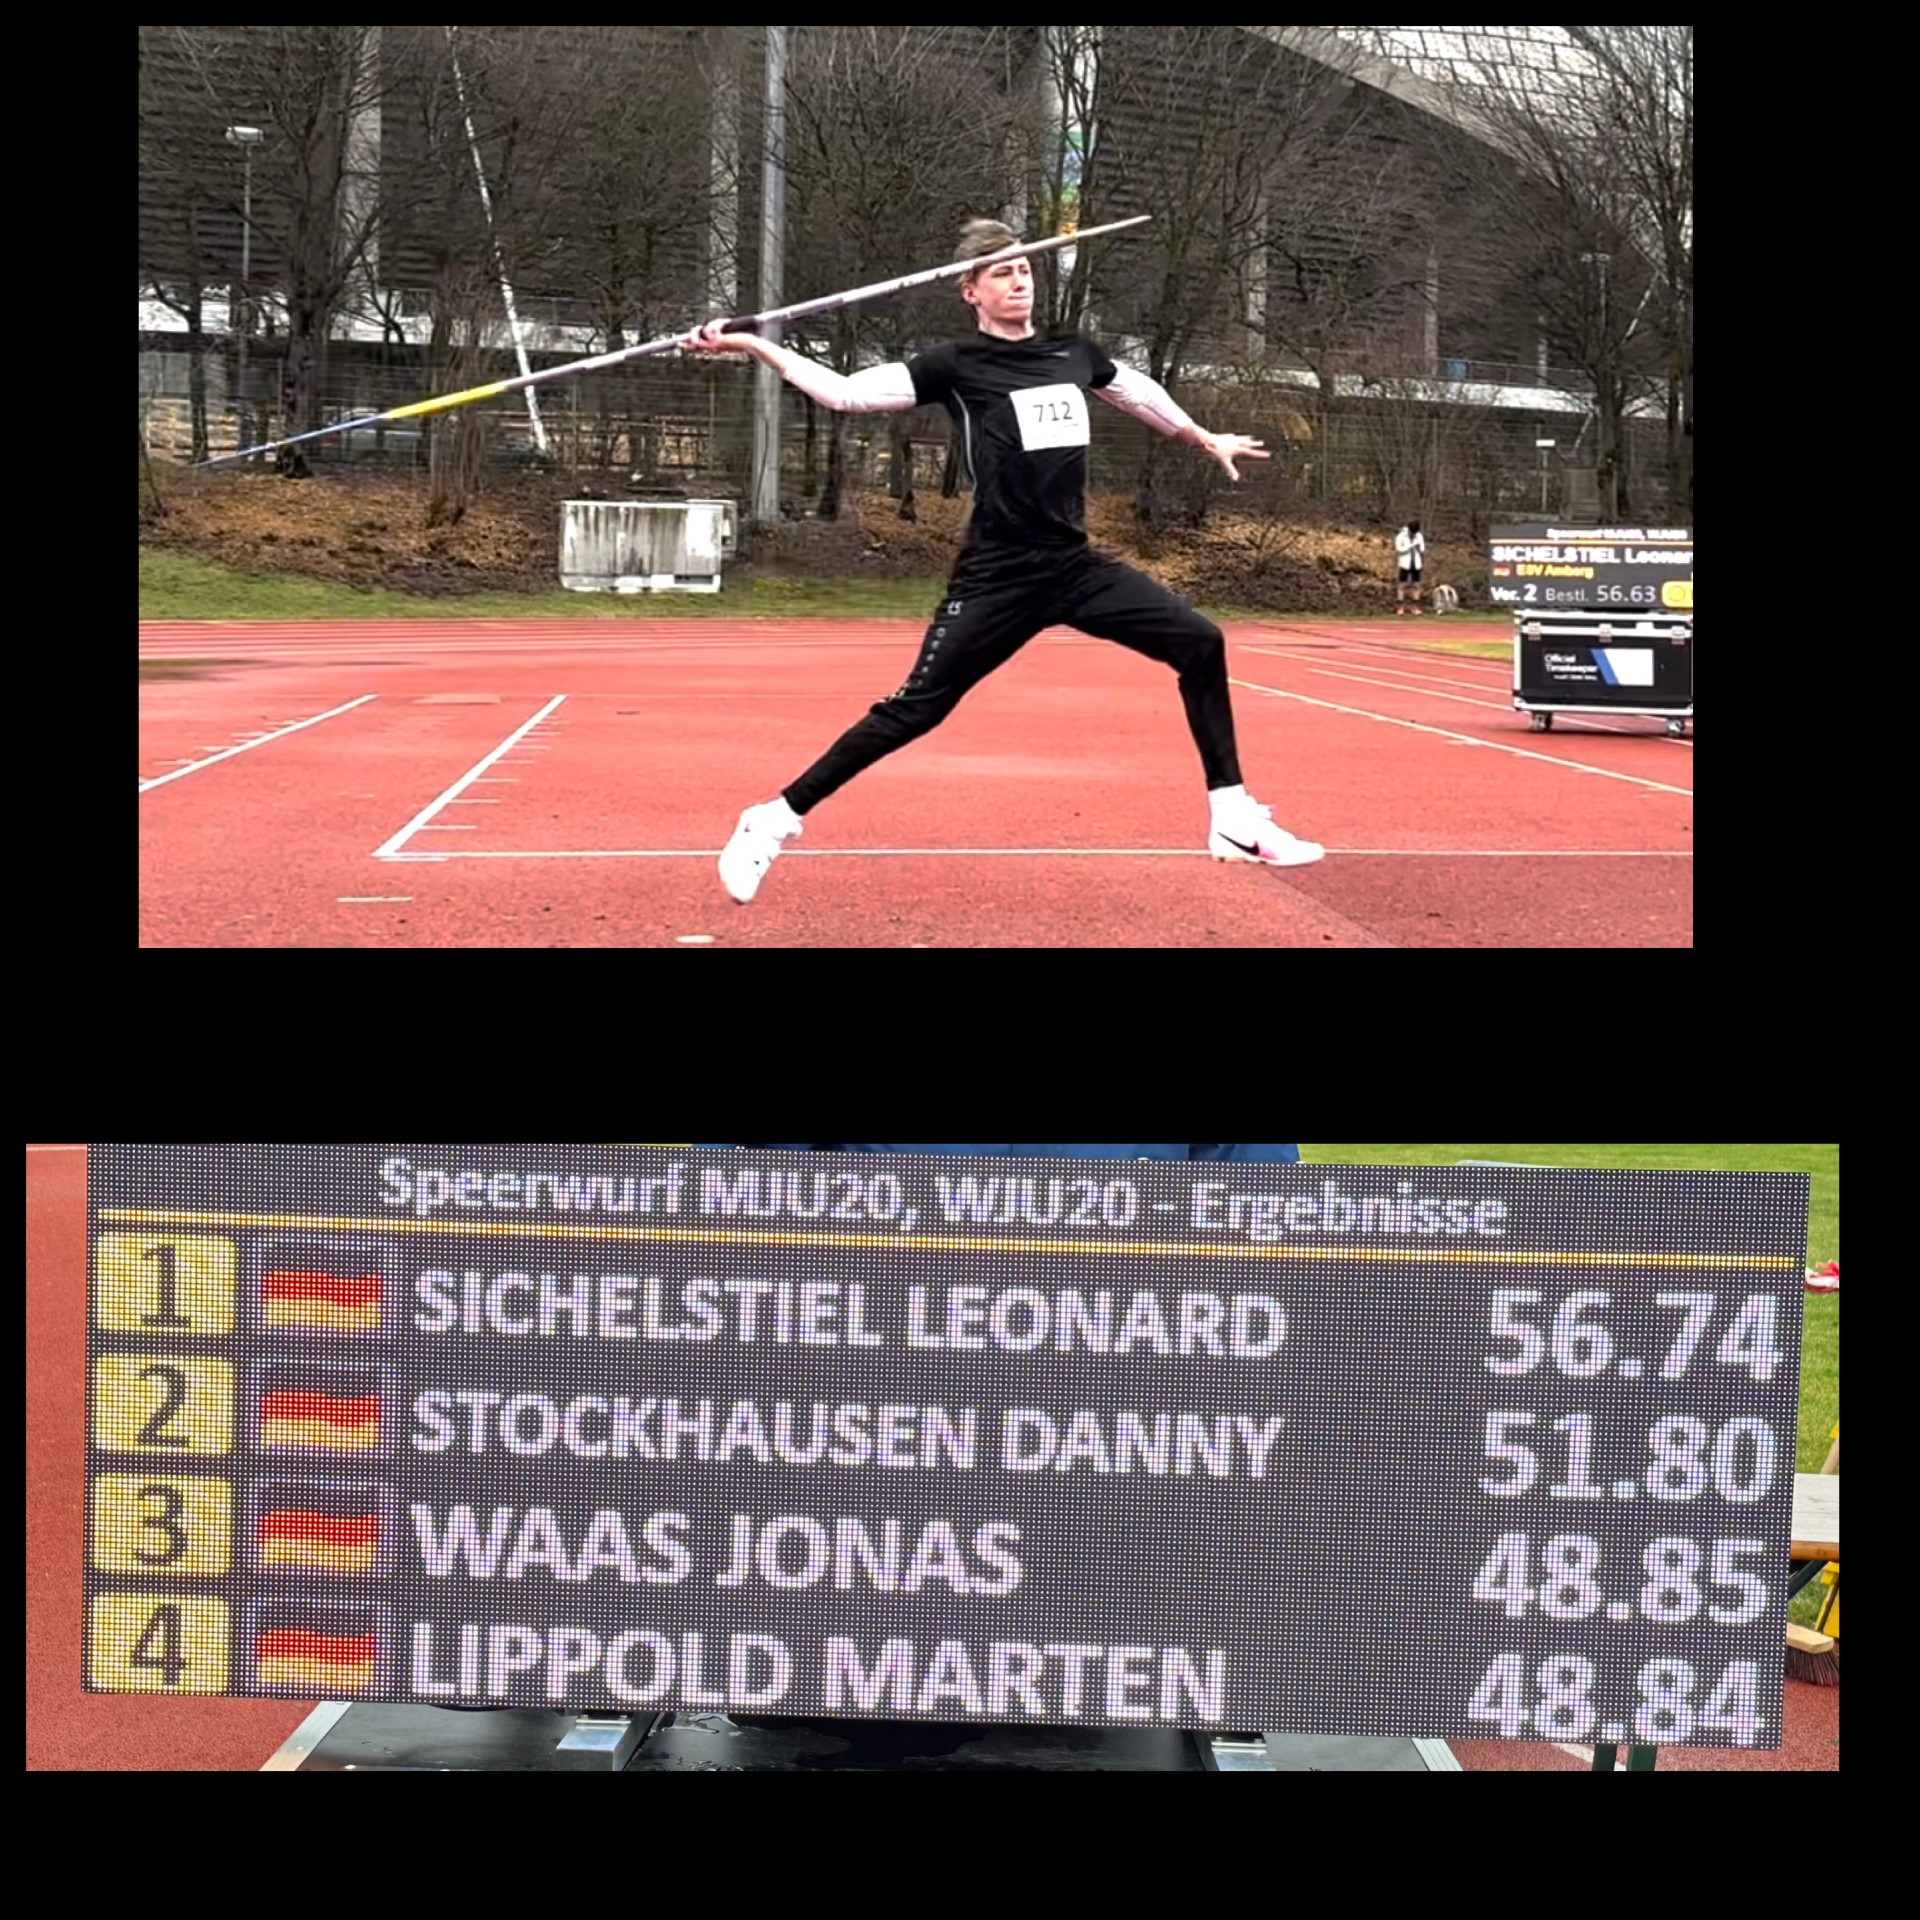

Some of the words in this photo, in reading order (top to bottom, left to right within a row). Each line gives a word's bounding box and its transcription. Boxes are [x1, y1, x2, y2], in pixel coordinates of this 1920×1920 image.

[1032, 401, 1073, 423] 712
[1491, 546, 1622, 564] SICHELSTIEL
[1524, 584, 1537, 601] 2
[1597, 585, 1656, 602] 56.63
[379, 1157, 687, 1215] Speerwurf
[700, 1168, 919, 1232] MJU20,
[935, 1176, 1139, 1227] WJU20
[1191, 1180, 1507, 1241] Ergebnisse
[140, 1244, 192, 1328] 1
[413, 1269, 882, 1347] SICHELSTIEL
[907, 1286, 1289, 1359] LEONARD
[1486, 1290, 1784, 1382] 56.74
[138, 1365, 191, 1447] 2
[411, 1391, 978, 1471] STOCKHAUSEN
[1003, 1409, 1284, 1478] DANNY
[1479, 1412, 1778, 1502] 51.80
[134, 1484, 188, 1567] 3
[410, 1503, 693, 1585] WAAS
[715, 1515, 1023, 1596] JONAS
[1472, 1532, 1771, 1625] 48.85
[130, 1603, 187, 1687] 4
[412, 1623, 793, 1705] LIPPOLD
[825, 1637, 1227, 1722] MARTEN
[1467, 1653, 1768, 1746] 48.84
